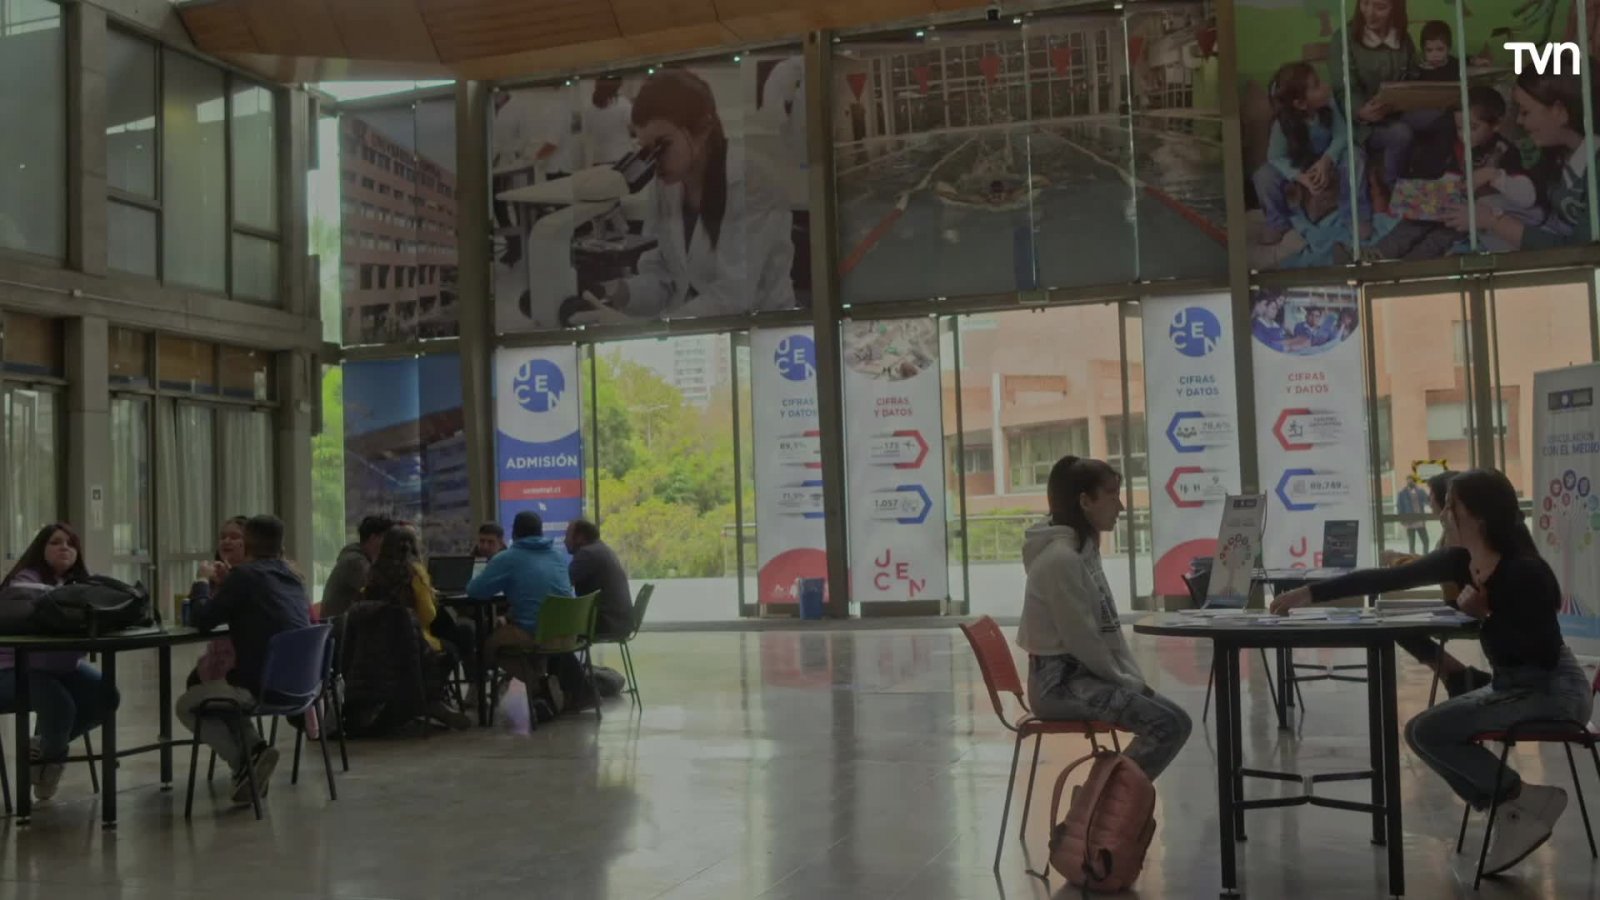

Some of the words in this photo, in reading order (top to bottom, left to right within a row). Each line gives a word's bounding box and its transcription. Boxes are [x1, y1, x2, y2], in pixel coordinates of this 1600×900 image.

[1179, 374, 1216, 385] CIFRAS
[1287, 371, 1326, 381] CIFRAS
[1176, 386, 1184, 397] Y
[1186, 386, 1219, 396] DATOS
[1285, 385, 1291, 394] Y
[1295, 384, 1329, 394] DATOS
[782, 397, 814, 407] CIFRAS
[876, 396, 910, 406] CIFRAS
[780, 409, 786, 419] Y
[873, 409, 880, 418] Y
[882, 407, 913, 417] DATOS
[505, 453, 578, 469] ADMISIÓN
